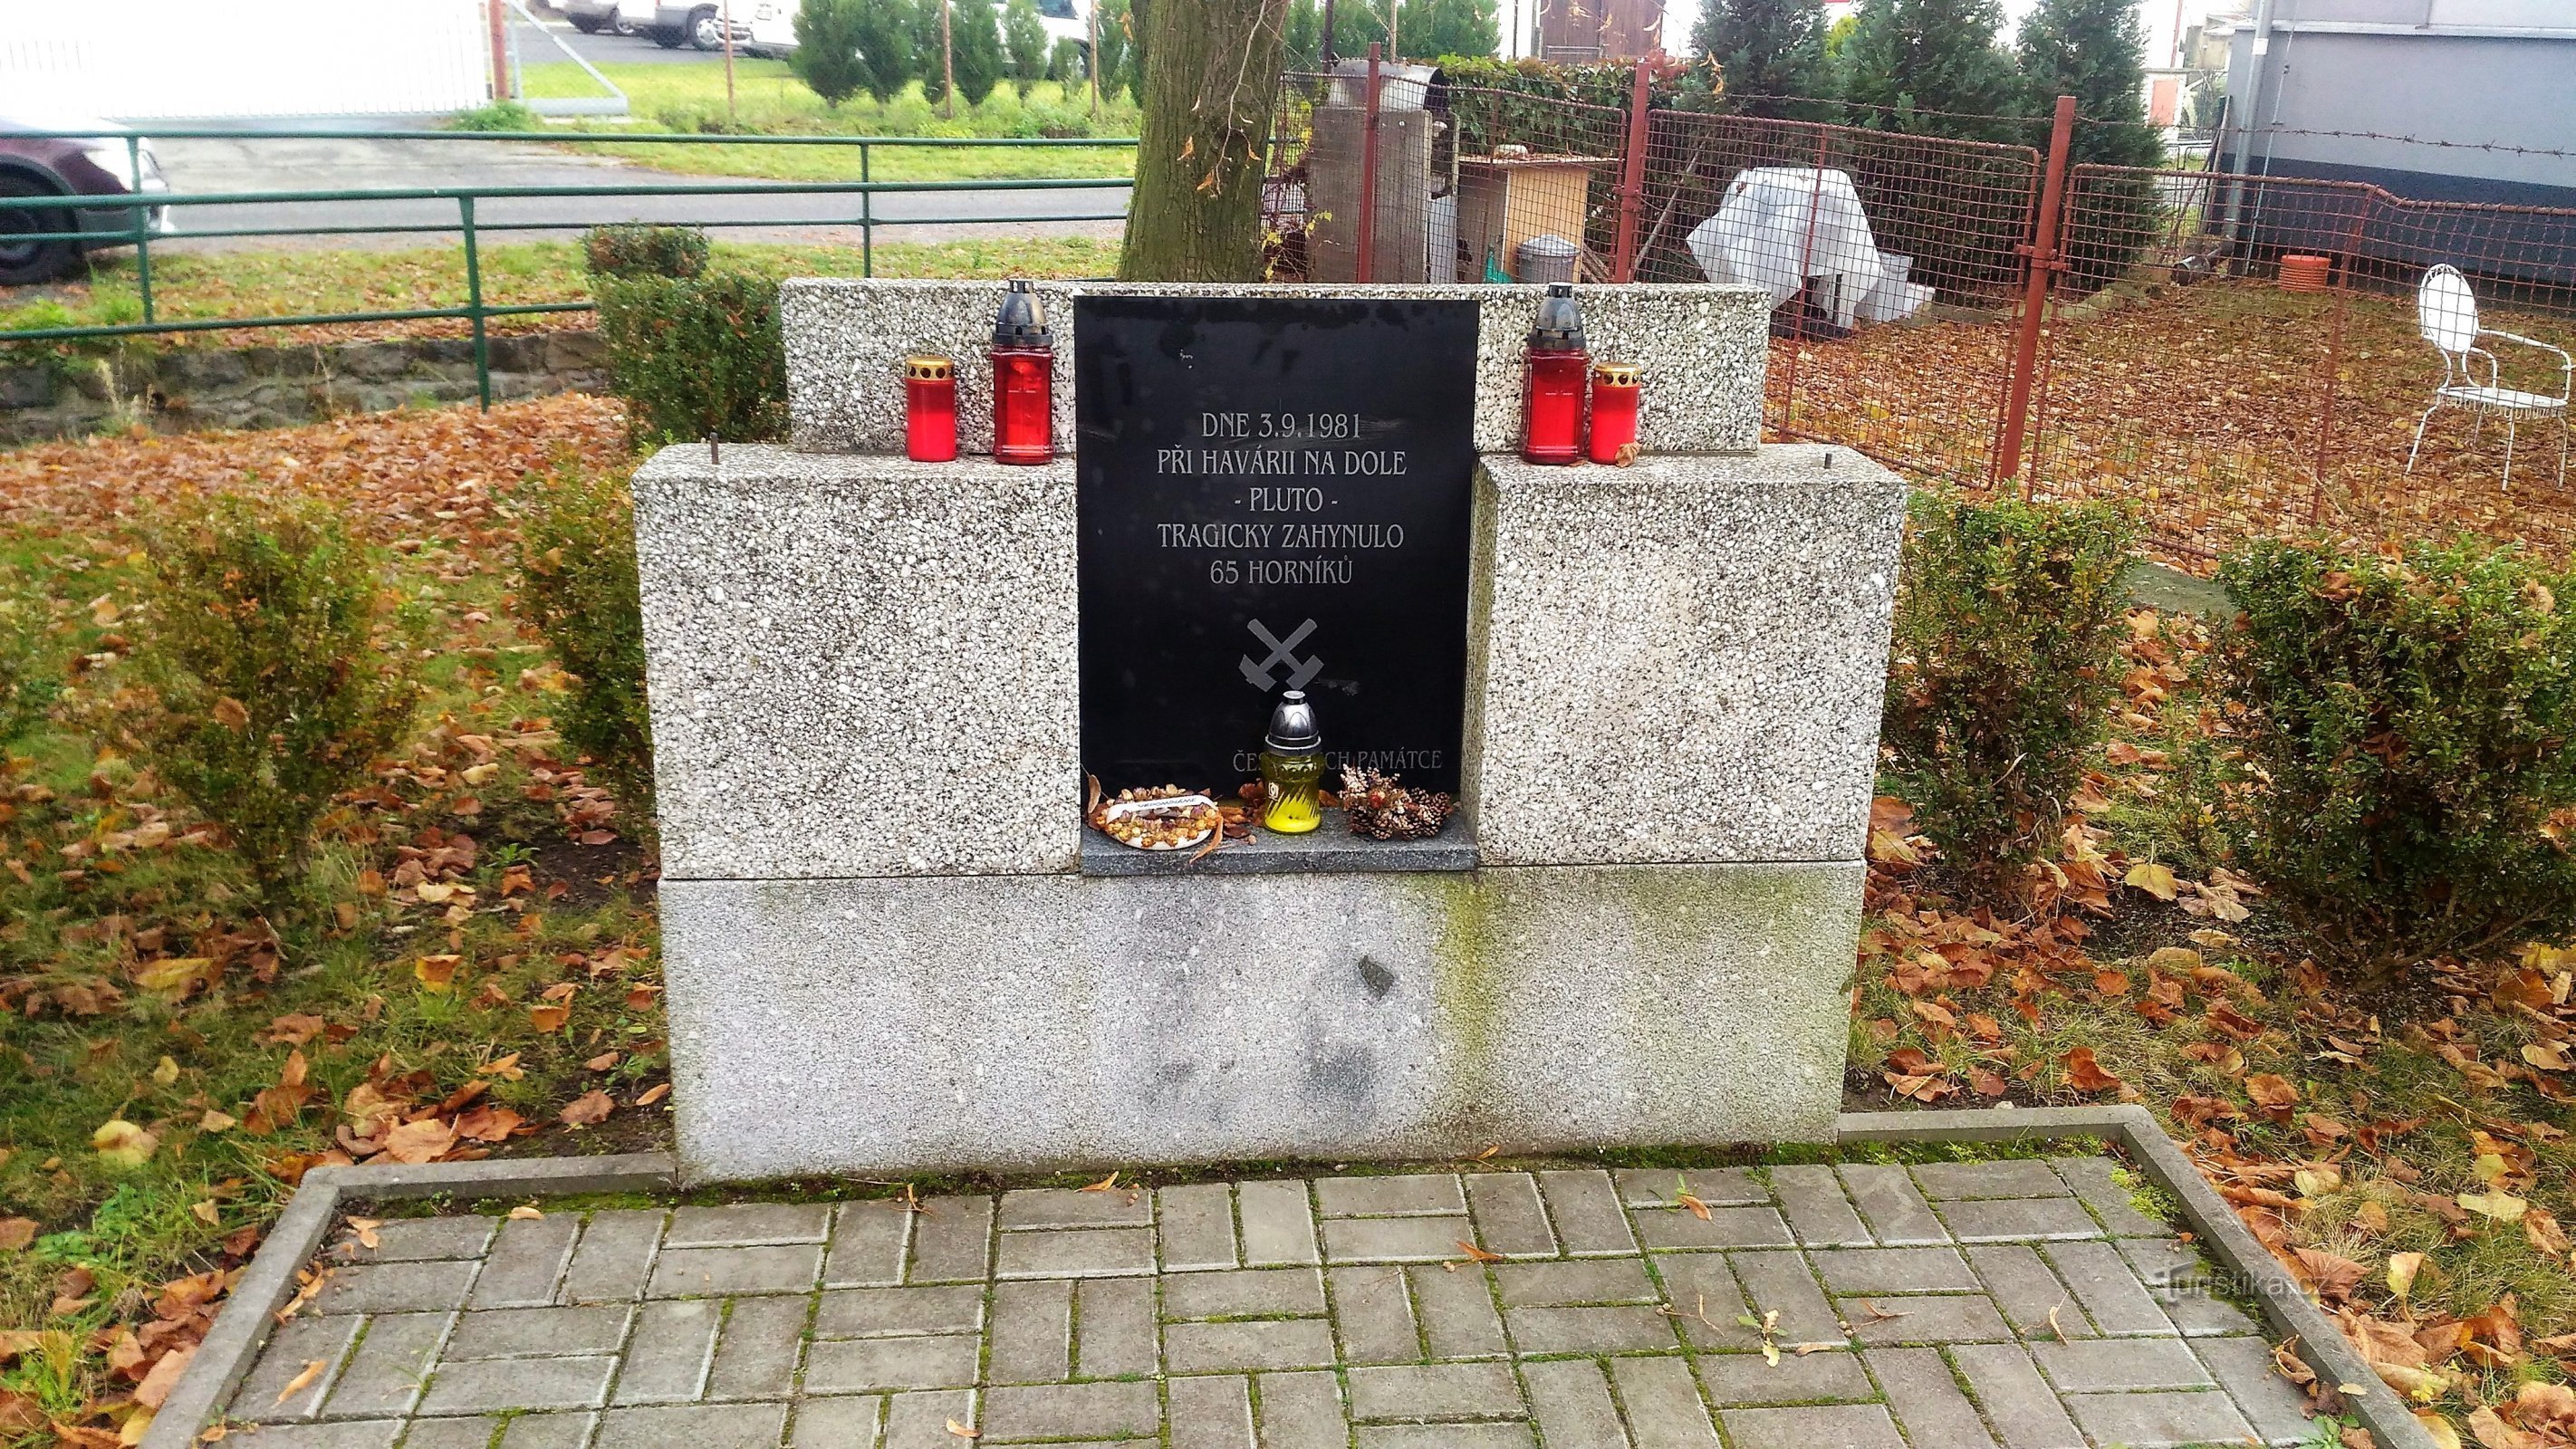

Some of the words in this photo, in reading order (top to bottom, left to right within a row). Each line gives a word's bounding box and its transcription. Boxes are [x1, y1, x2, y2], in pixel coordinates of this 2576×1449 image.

[1202, 413, 1250, 437] DNE
[1258, 413, 1360, 438] 3.9.1981
[1158, 444, 1193, 475] PŘI
[1202, 444, 1295, 475] HAVÁRII
[1304, 450, 1336, 475] NA
[1344, 450, 1408, 475] DOLE
[1249, 486, 1323, 513] PLUTO
[1158, 523, 1274, 548] TRAGICKY
[1282, 523, 1404, 548] ZAHYNULO
[1210, 561, 1239, 584] 65
[1249, 554, 1352, 584] HORNÍKŮ
[1358, 746, 1442, 769] PAMÁTCE
